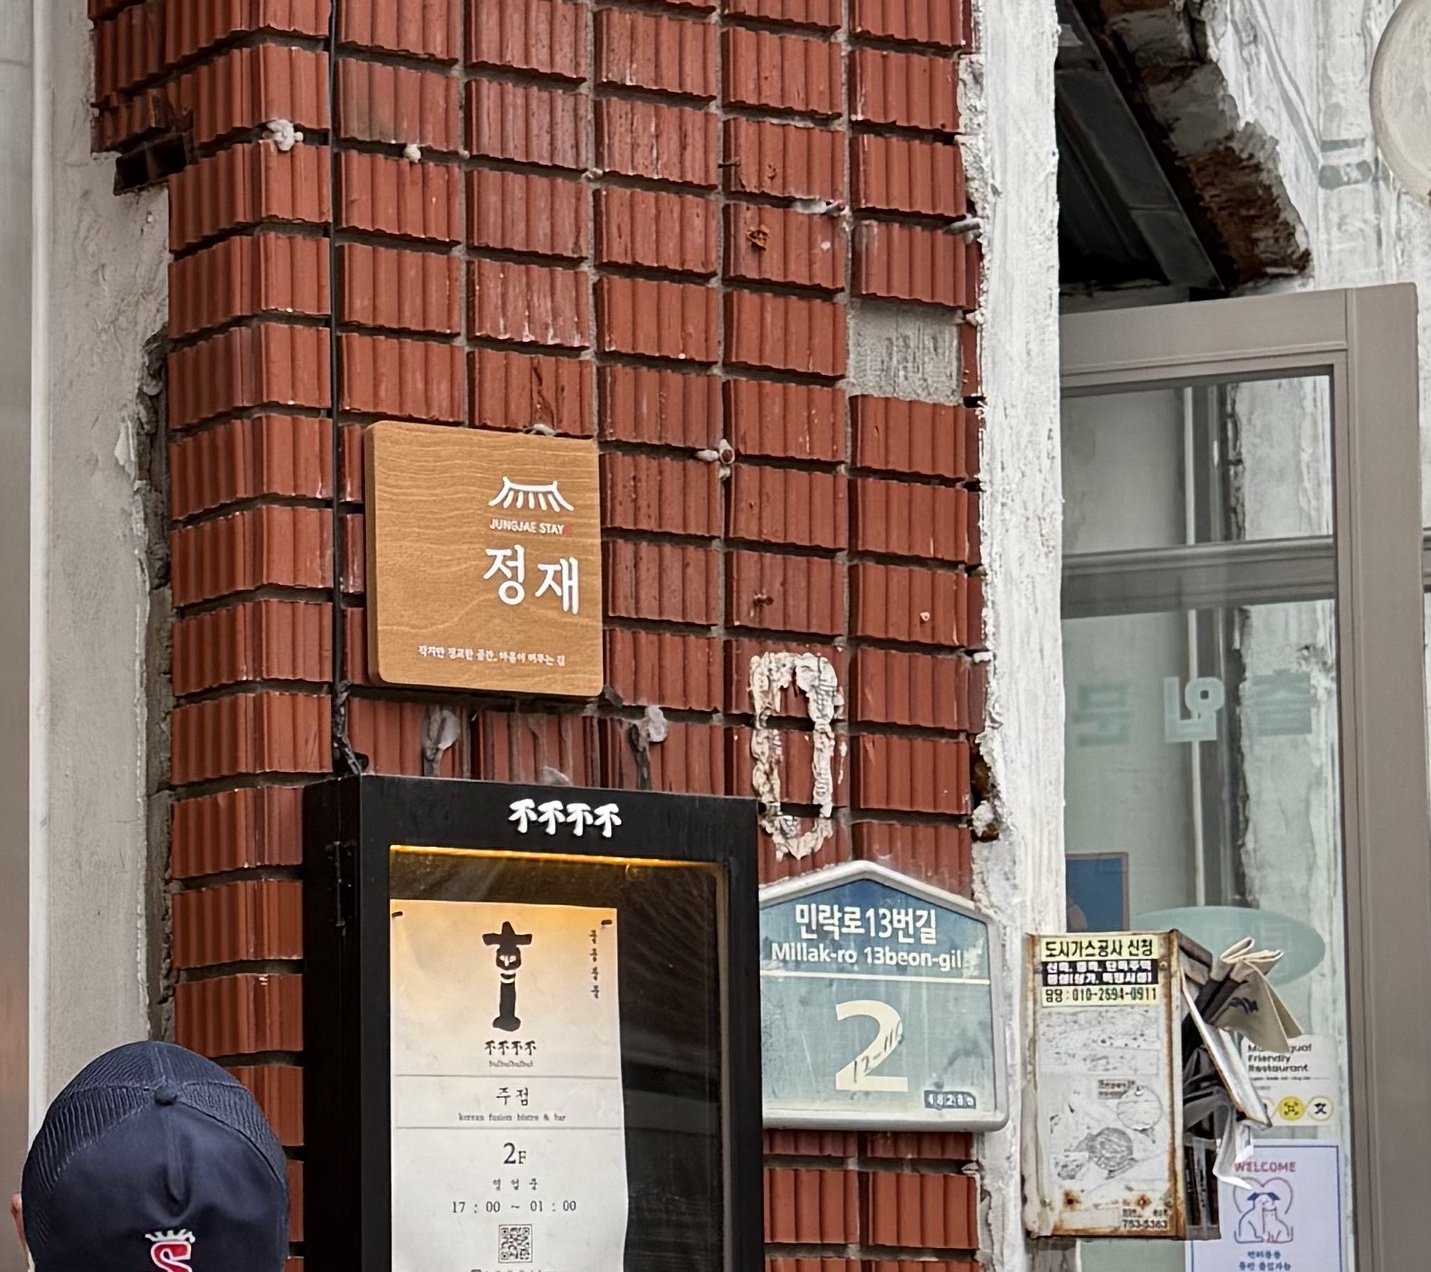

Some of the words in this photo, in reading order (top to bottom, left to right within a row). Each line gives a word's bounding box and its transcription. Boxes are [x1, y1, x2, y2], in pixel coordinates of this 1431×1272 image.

[489, 518, 537, 533] JUNGJAE
[539, 522, 565, 535] STAY
[482, 544, 580, 614] 정재
[508, 798, 622, 838] 不不不不
[795, 903, 937, 945] 민락로13번길
[771, 942, 858, 964] Millak-ro
[864, 946, 962, 972] 13beon-gil
[1045, 939, 1123, 958] 도시가스공사
[1128, 938, 1153, 957] 신청
[484, 1039, 537, 1056] 不不不不
[835, 999, 909, 1092] 2
[1248, 1054, 1291, 1064] Friendly
[1248, 1063, 1309, 1073] Restaurant
[496, 1087, 529, 1106] 주점
[503, 1142, 527, 1165] 2F
[1234, 1161, 1297, 1173] WELCOME
